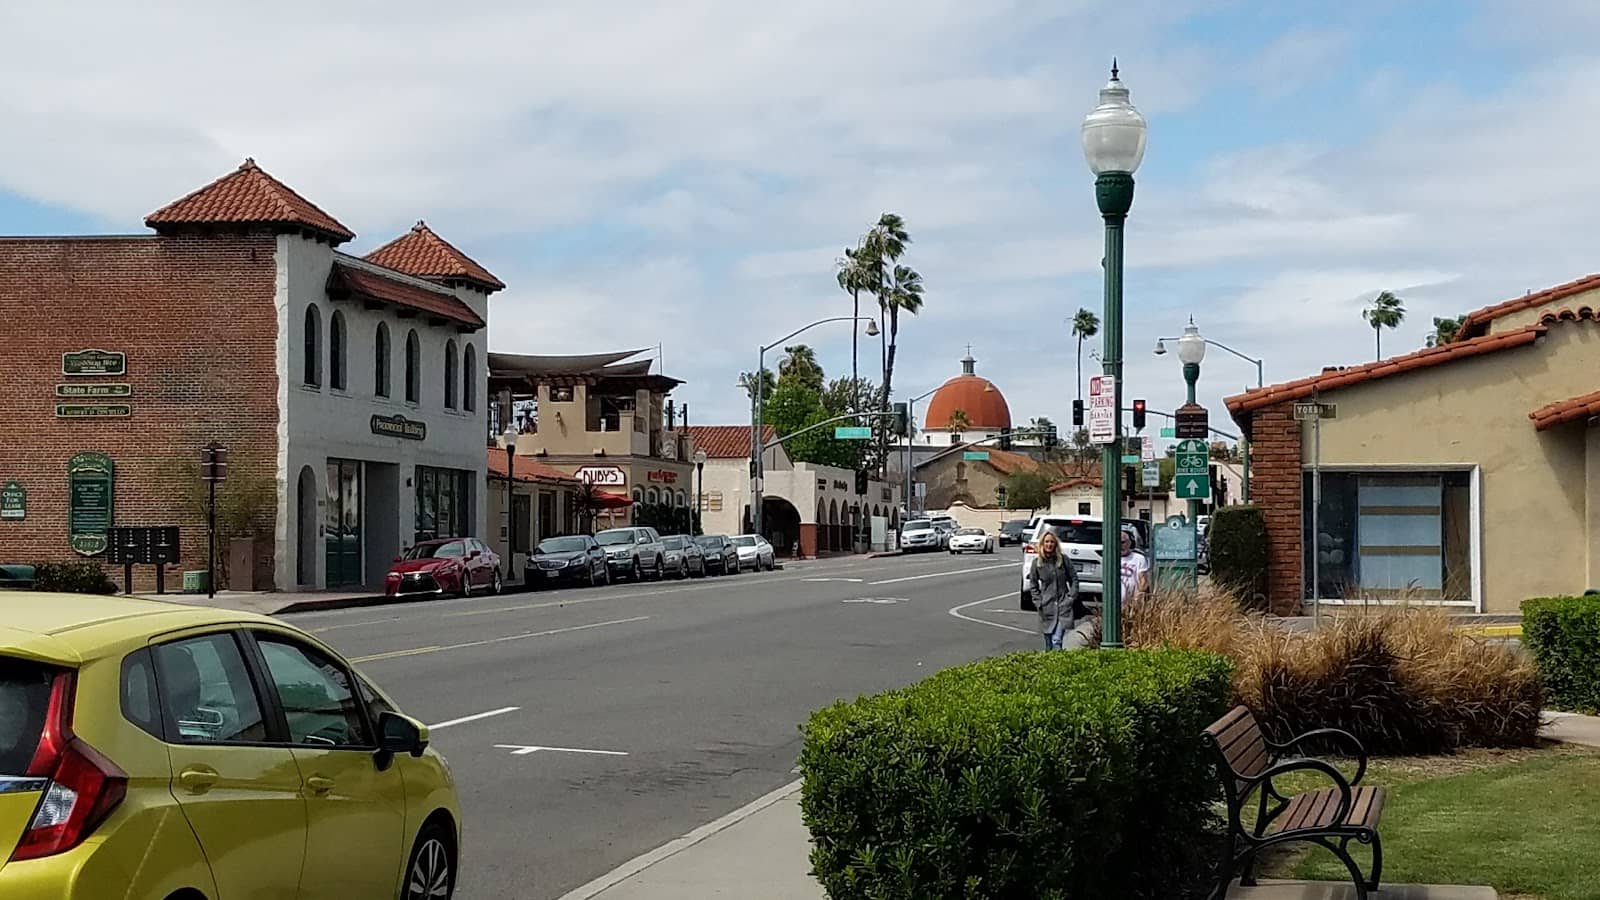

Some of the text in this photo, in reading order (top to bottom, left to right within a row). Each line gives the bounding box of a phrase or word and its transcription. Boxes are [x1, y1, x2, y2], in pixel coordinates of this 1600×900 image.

[63, 386, 85, 394] State
[87, 386, 109, 394] Farm
[1091, 380, 1101, 394] NO
[1090, 396, 1113, 408] PARKING
[1297, 405, 1324, 414] YORBA
